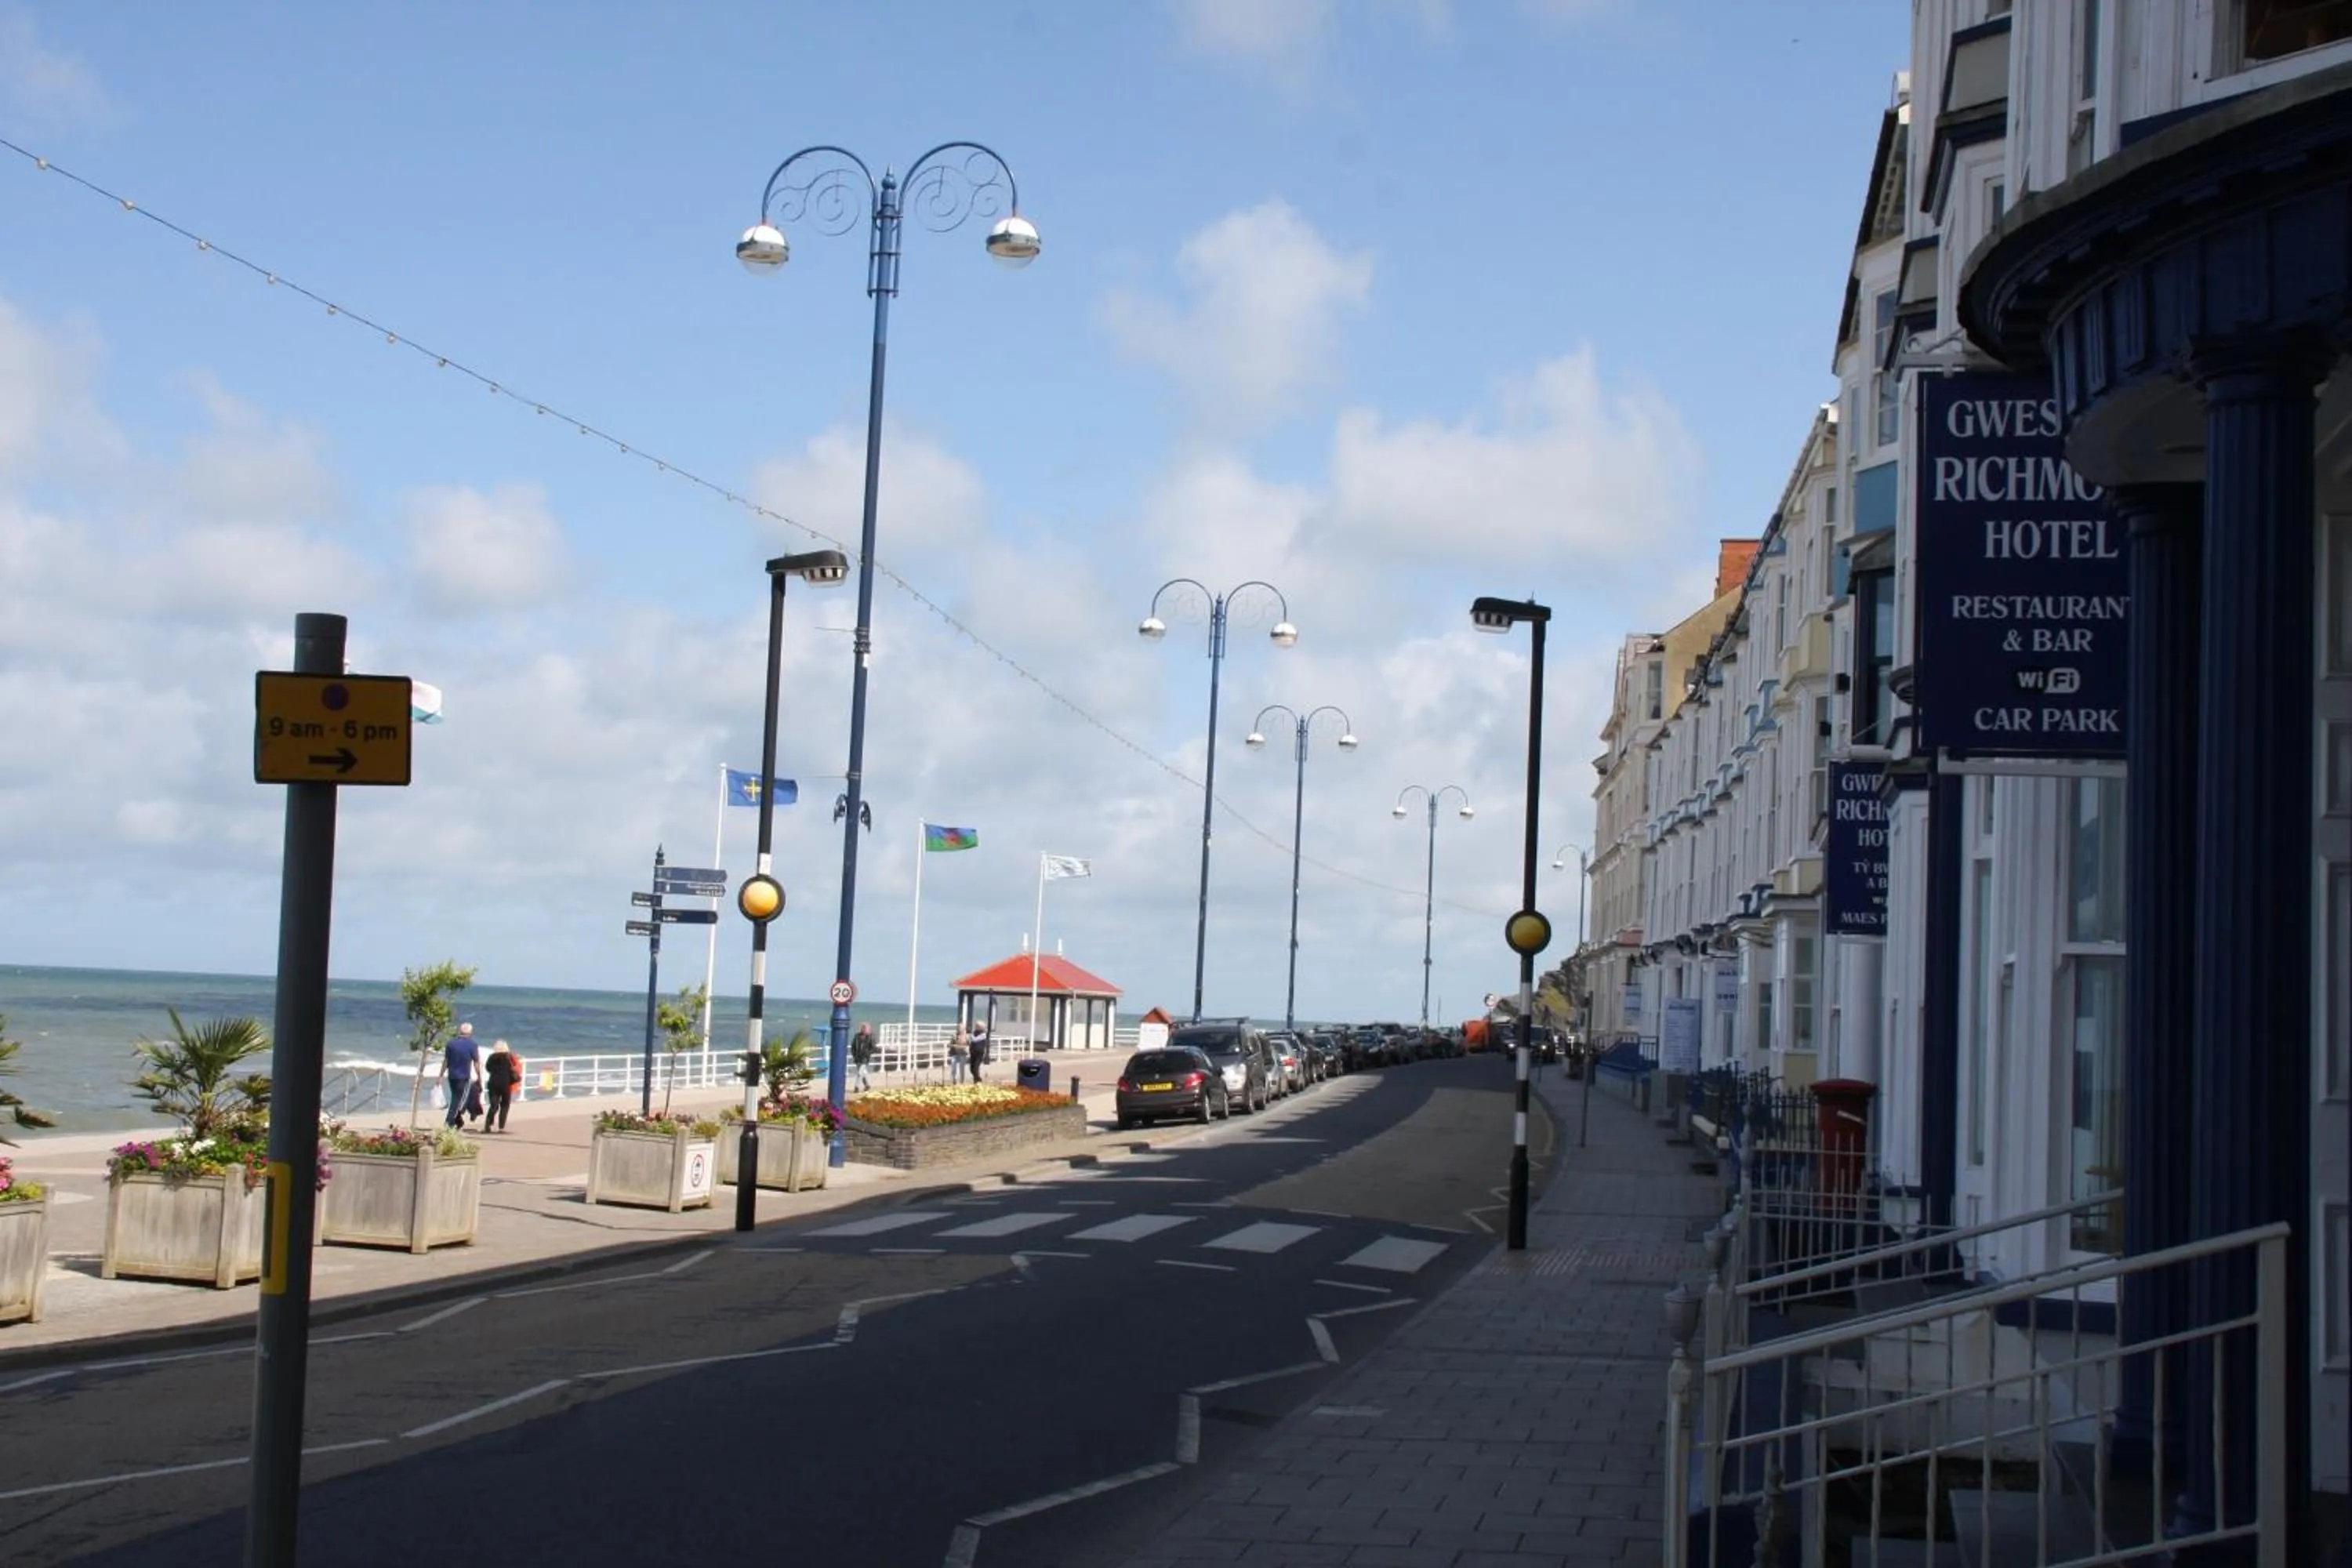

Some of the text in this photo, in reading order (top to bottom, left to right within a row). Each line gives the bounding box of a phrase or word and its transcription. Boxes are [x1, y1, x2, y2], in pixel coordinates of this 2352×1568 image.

[1947, 399, 2060, 437] GWES
[1933, 456, 2104, 502] RICHMO
[1984, 519, 2119, 559] HOTEL
[1951, 595, 2130, 619] RESTAURAN
[2002, 629, 2093, 652] & BAR
[269, 716, 284, 736] 9
[289, 722, 324, 739] am
[343, 719, 358, 739] 6
[363, 725, 397, 743] pm
[1974, 707, 2120, 733] CAR PARK
[1835, 798, 1888, 821] RICH
[1840, 911, 1878, 925] MAES
[833, 987, 851, 998] 20
